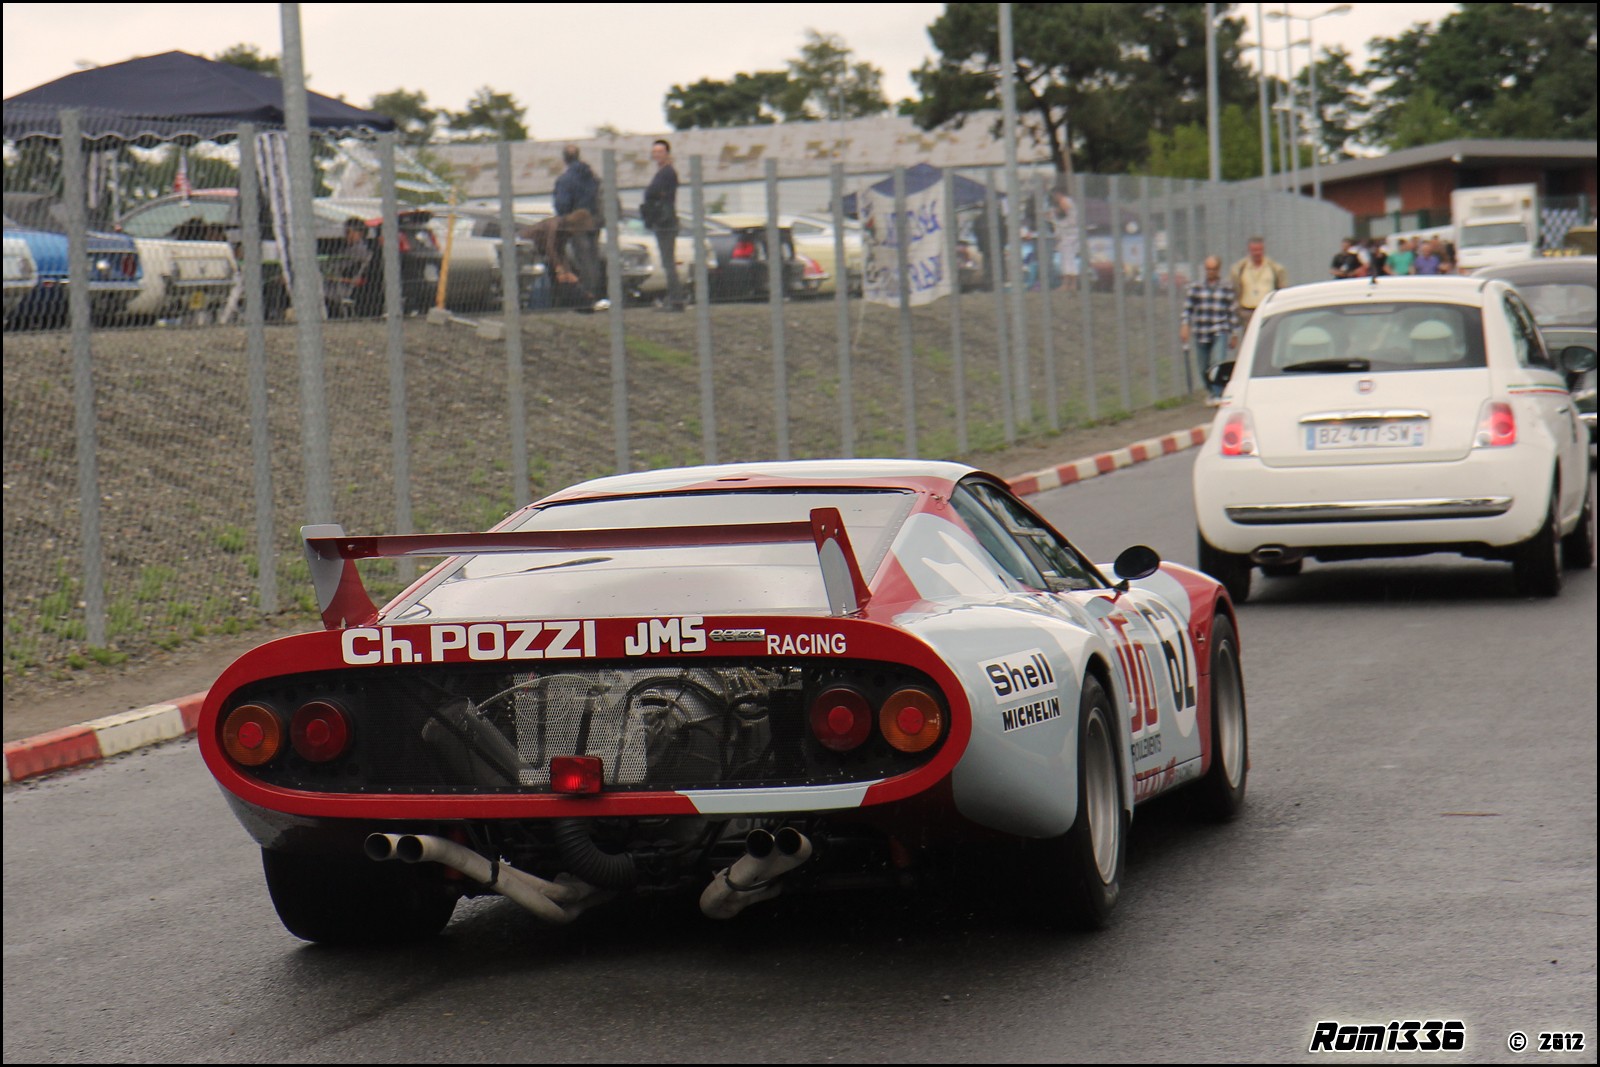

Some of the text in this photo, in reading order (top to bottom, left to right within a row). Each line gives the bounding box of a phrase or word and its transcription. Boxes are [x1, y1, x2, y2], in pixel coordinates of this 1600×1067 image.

[1319, 425, 1410, 444] BZ-477-SW
[341, 616, 847, 664] Ch. POZZI JMS RACING
[1134, 598, 1196, 712] 62
[985, 653, 1054, 696] Shell
[1002, 697, 1060, 731] MICHELIN
